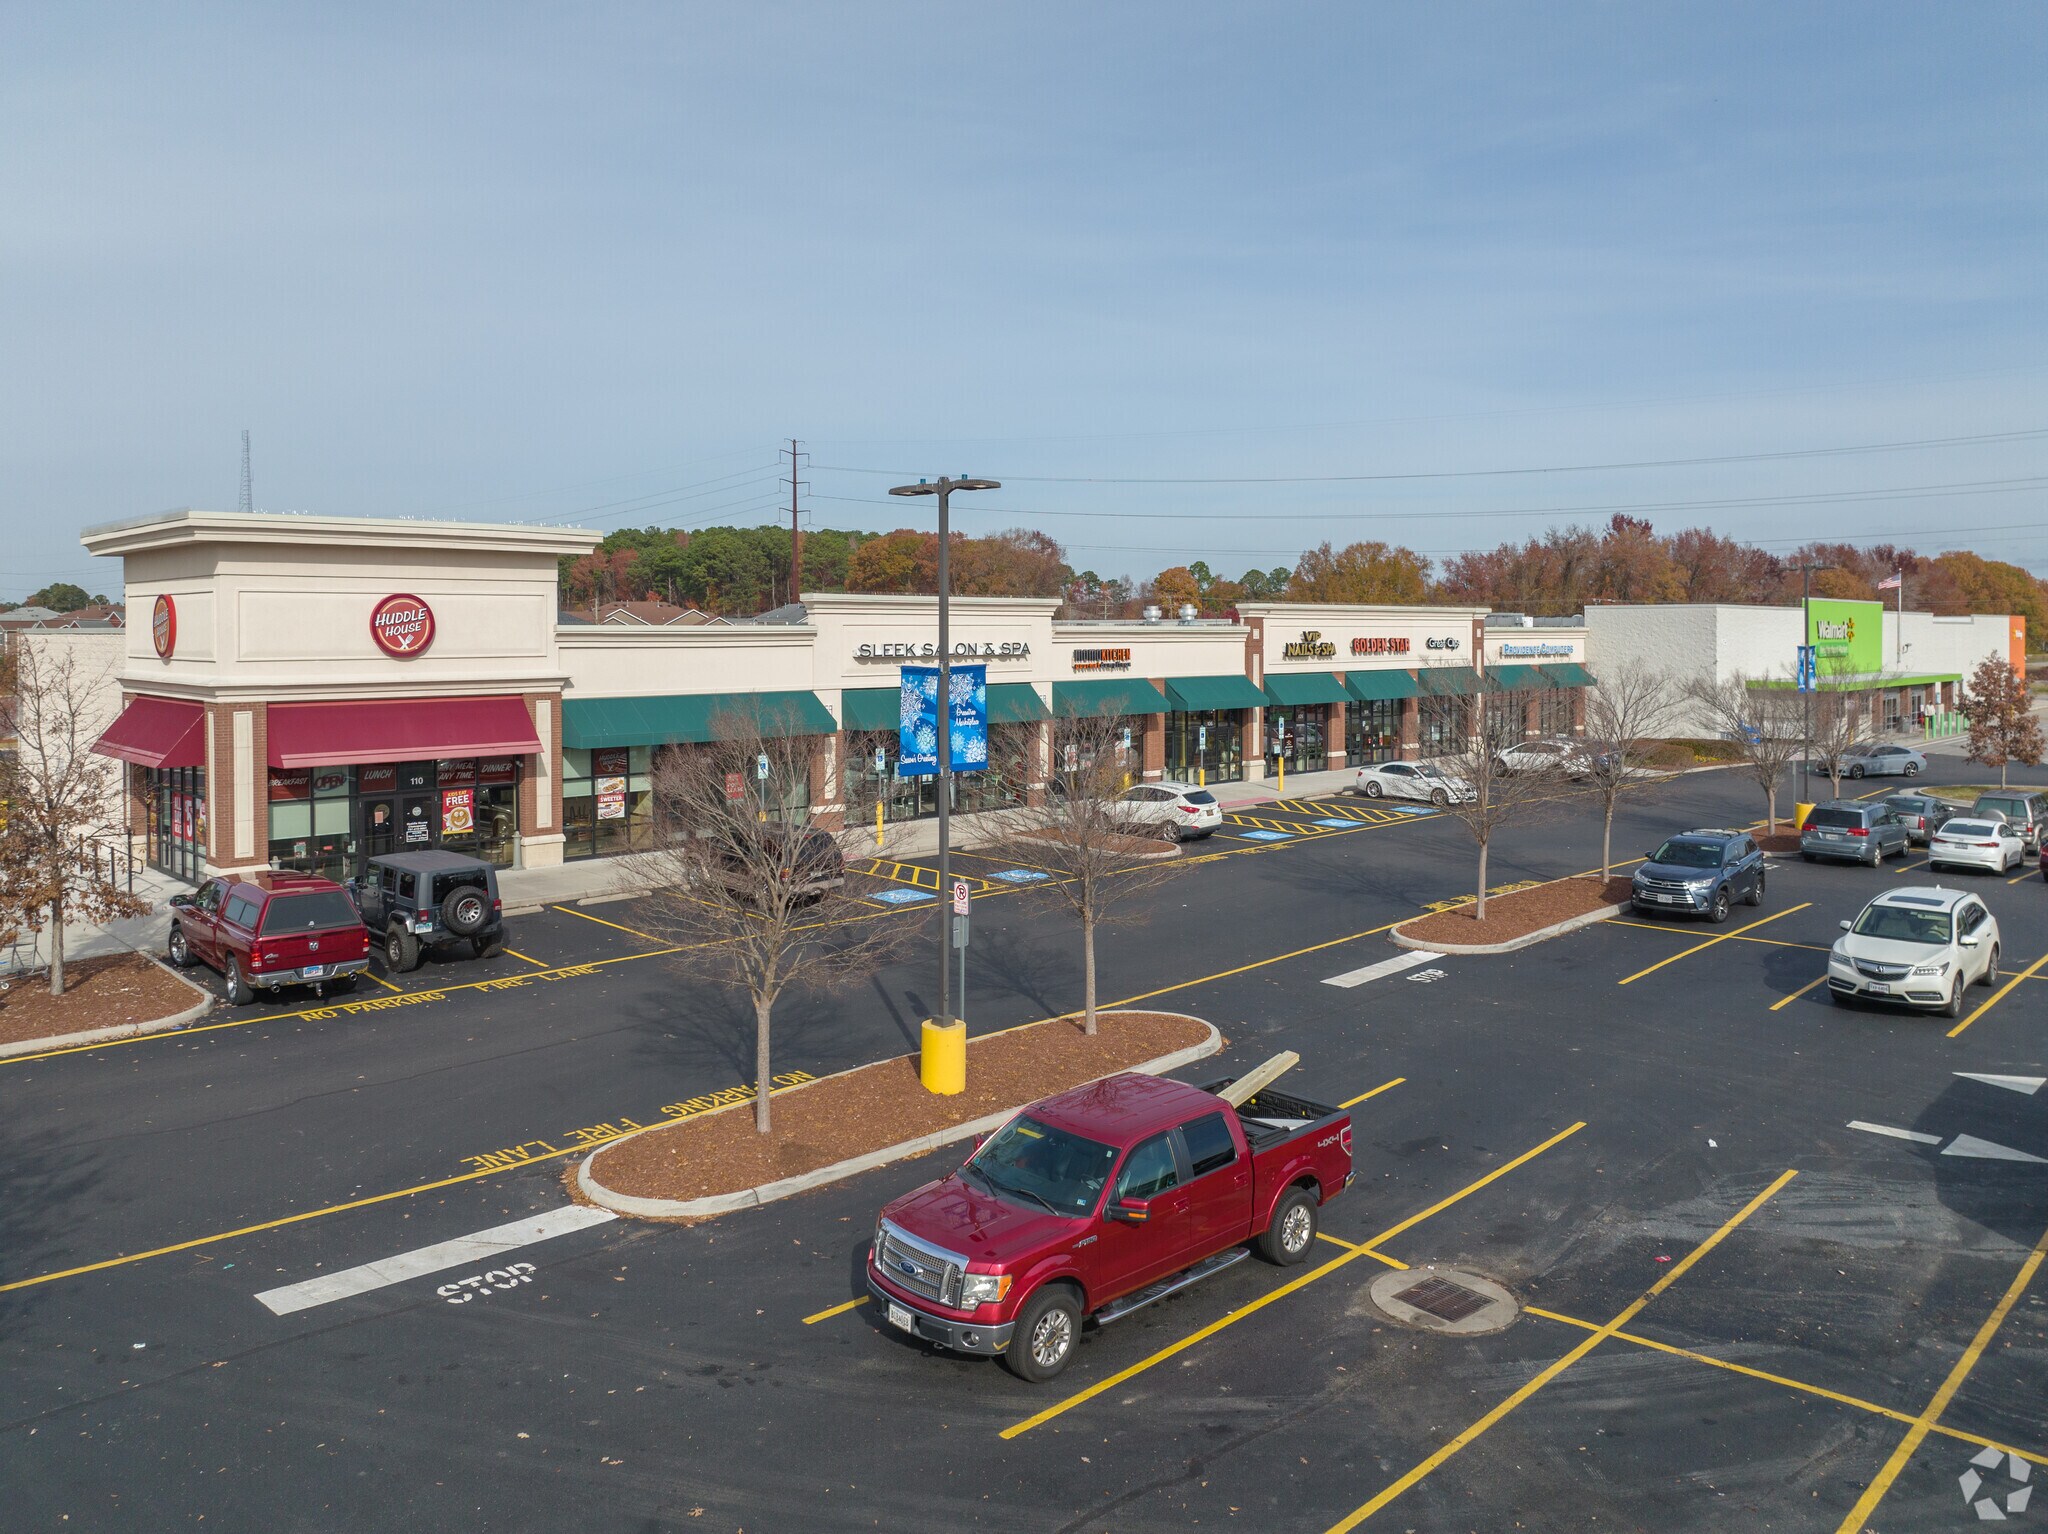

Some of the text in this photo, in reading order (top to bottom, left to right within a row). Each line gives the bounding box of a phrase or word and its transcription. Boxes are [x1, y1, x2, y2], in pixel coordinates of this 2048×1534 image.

[375, 608, 427, 627] HUDDLE
[385, 622, 422, 637] HOUSE
[1303, 631, 1321, 642] VIP
[1817, 620, 1847, 639] Walmart
[1286, 642, 1314, 656] NAILS
[1322, 642, 1337, 656] SPA
[1352, 638, 1410, 652] GOLDEN STAR
[1427, 637, 1445, 648] Great
[860, 643, 916, 657] SLEEK
[985, 643, 995, 655] &
[1001, 643, 1031, 655] SPA
[364, 769, 393, 780] LUNCH
[481, 762, 513, 773] DINNER
[268, 777, 309, 787] BREAKFAST
[410, 777, 424, 785] 110
[446, 795, 470, 806] FREE
[600, 795, 622, 803] SWEETER
[299, 965, 603, 1022] NO PARKING FIRE LANE
[772, 1070, 816, 1085] NO
[563, 1118, 646, 1145] FIRE
[460, 1140, 557, 1172] LANE
[437, 1262, 537, 1304] STOP
